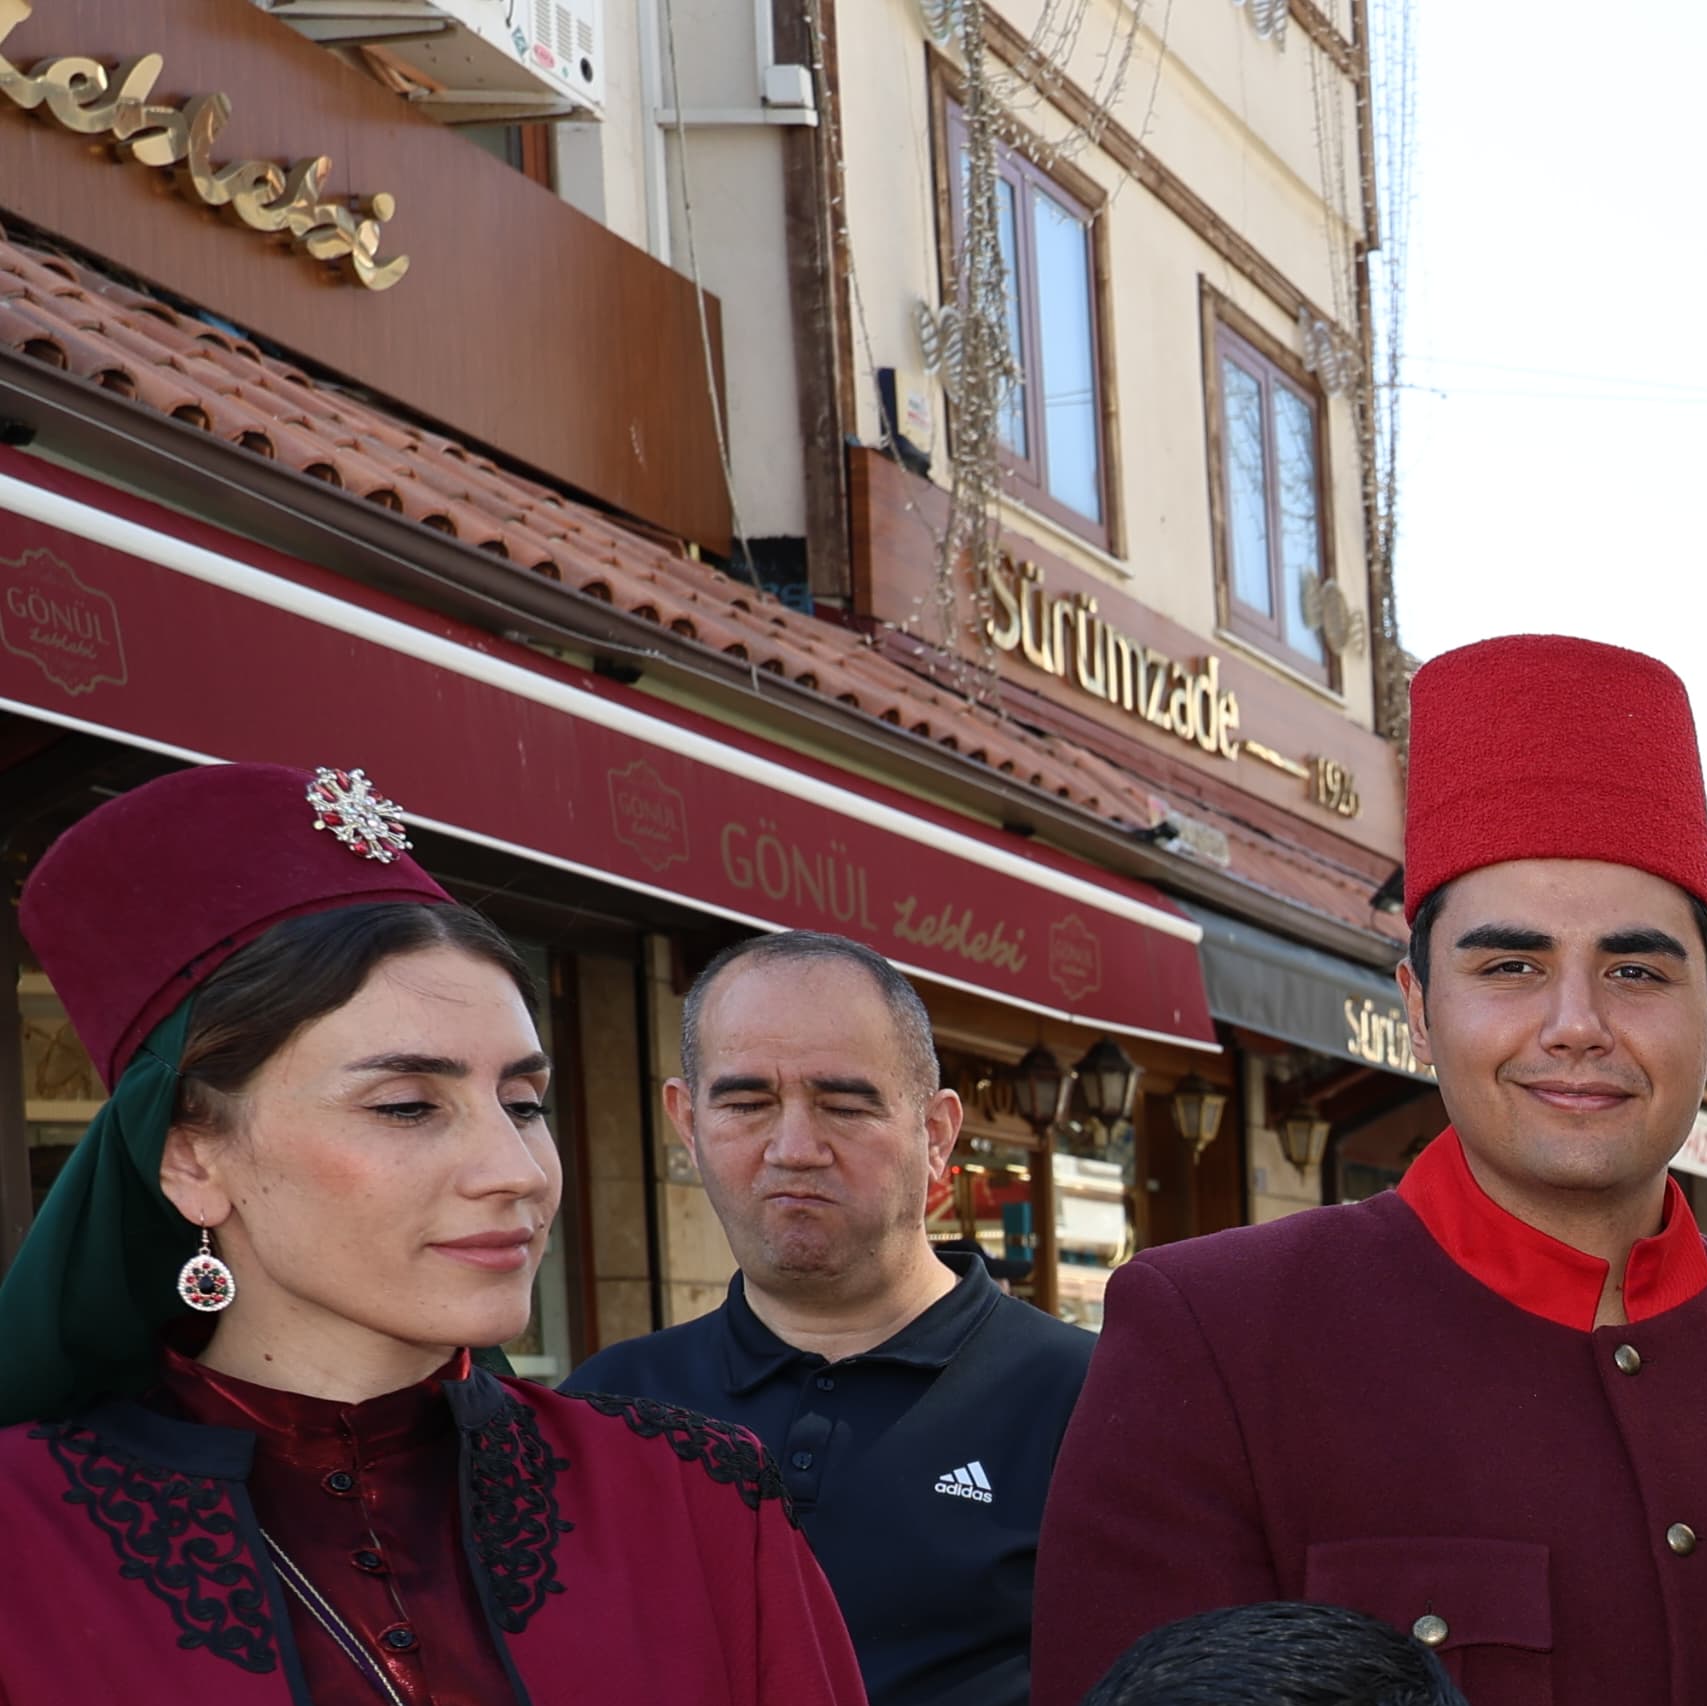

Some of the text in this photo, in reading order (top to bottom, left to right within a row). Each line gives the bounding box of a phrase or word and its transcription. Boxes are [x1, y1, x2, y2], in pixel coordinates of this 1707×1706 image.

[6, 586, 111, 645] GÖNÜL
[986, 552, 1240, 761] Sürümzade
[720, 817, 1027, 973] GÖNÜL Leblebi
[934, 1481, 993, 1504] adidas
